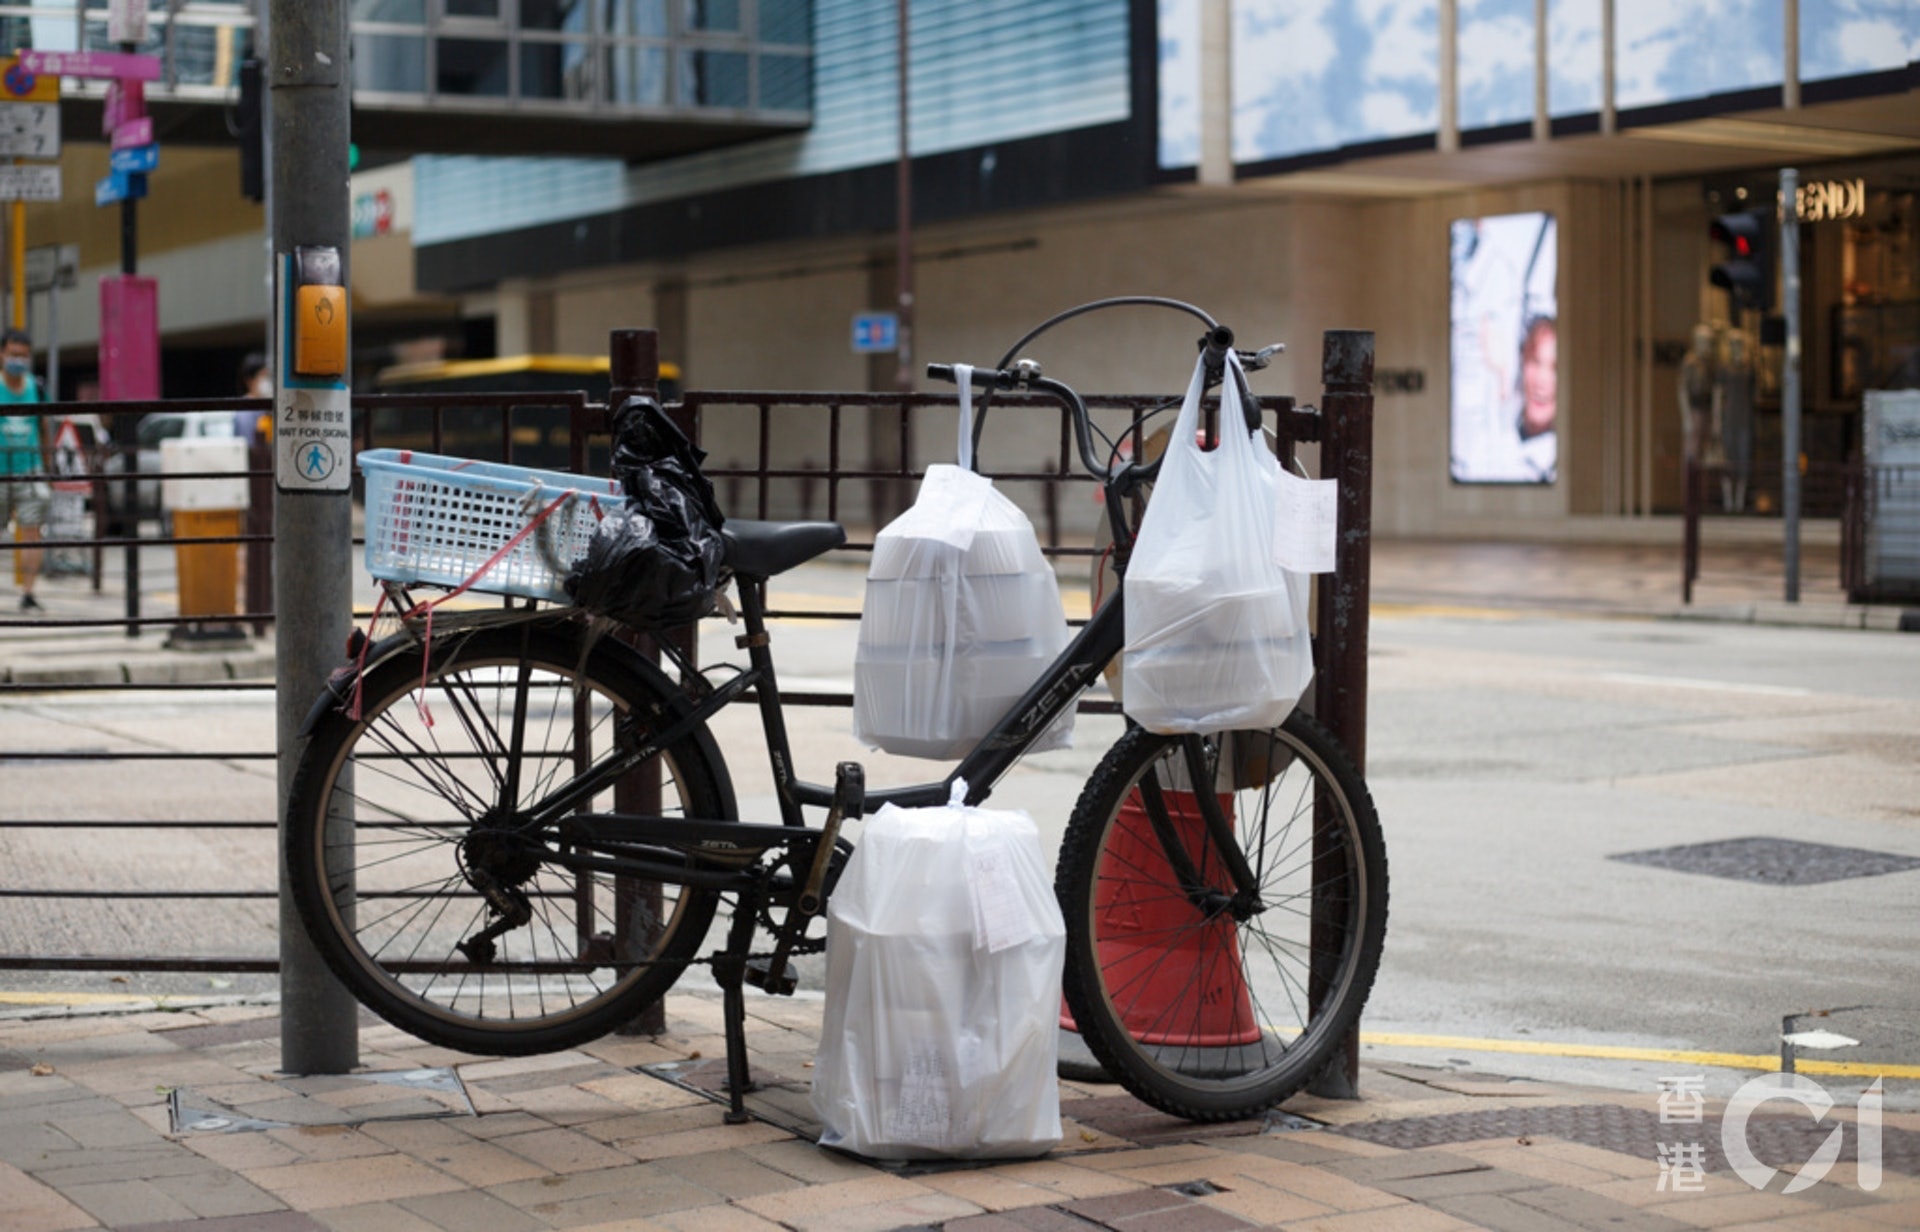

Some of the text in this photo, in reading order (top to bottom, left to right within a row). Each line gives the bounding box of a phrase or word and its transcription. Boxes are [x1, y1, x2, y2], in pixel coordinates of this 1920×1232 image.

[284, 406, 294, 422] 2
[299, 427, 320, 438] FOR
[322, 428, 350, 439] SIGNAL
[1021, 662, 1094, 732] ZETA
[701, 840, 738, 850] ZETA
